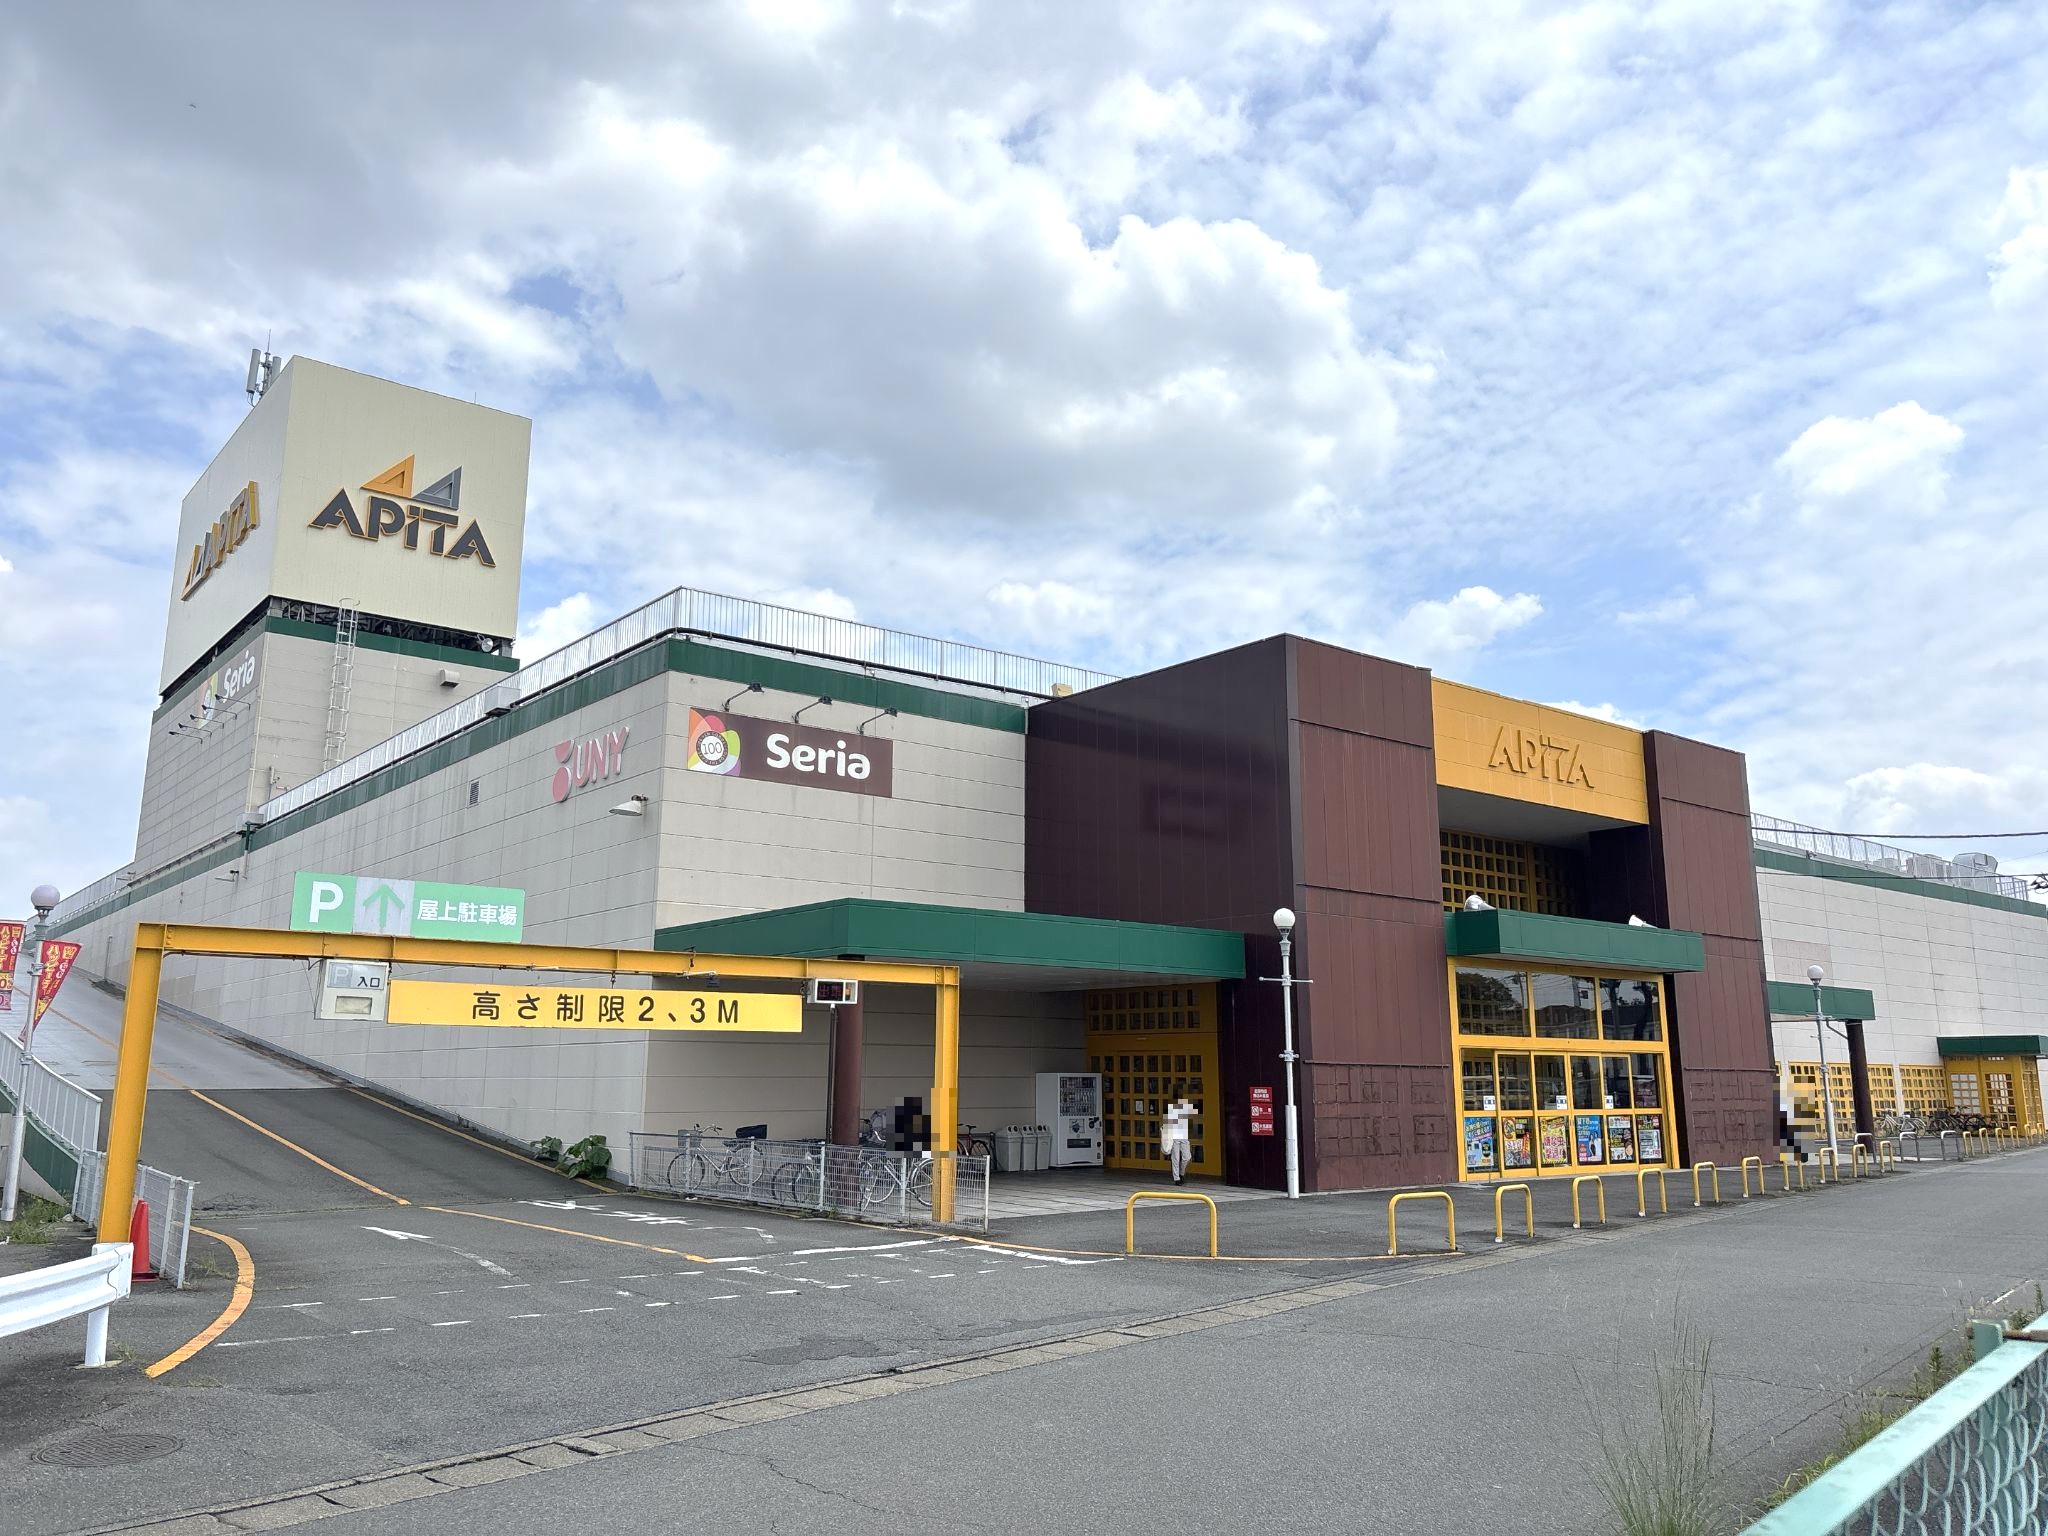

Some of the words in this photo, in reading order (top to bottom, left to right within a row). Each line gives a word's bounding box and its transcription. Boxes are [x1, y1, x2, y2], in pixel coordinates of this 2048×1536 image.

[223, 649, 256, 703] Seria
[702, 742, 723, 755] 100
[766, 733, 871, 780] Seria
[309, 881, 344, 923] P
[417, 900, 518, 926] 屋上駐車場
[333, 966, 349, 985] P
[357, 976, 380, 988] 入口
